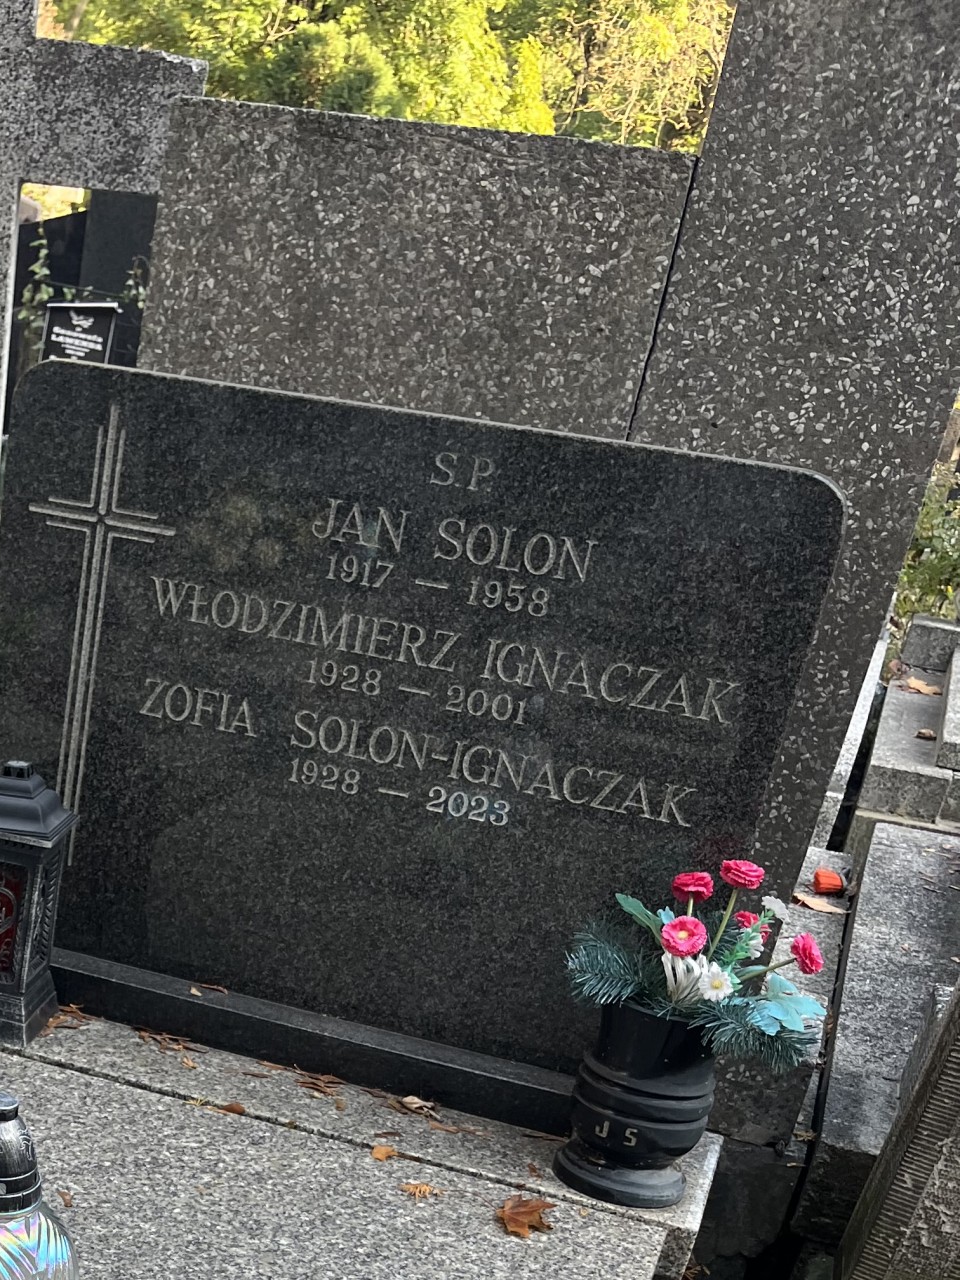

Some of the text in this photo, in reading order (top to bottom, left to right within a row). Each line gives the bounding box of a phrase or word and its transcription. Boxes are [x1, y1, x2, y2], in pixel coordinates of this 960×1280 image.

[311, 498, 600, 583] JAN SOLON
[325, 553, 396, 590] 1917
[466, 580, 550, 617] 1958
[149, 575, 741, 725] WŁODZIMIERZ IGNACZAK
[307, 659, 382, 697] 1928
[446, 683, 529, 725] 2001
[138, 677, 698, 828] ZOFIA SOLON-IGNACZAK
[287, 757, 362, 796] 1928
[425, 784, 513, 827] 2023
[595, 1120, 639, 1147] J S
